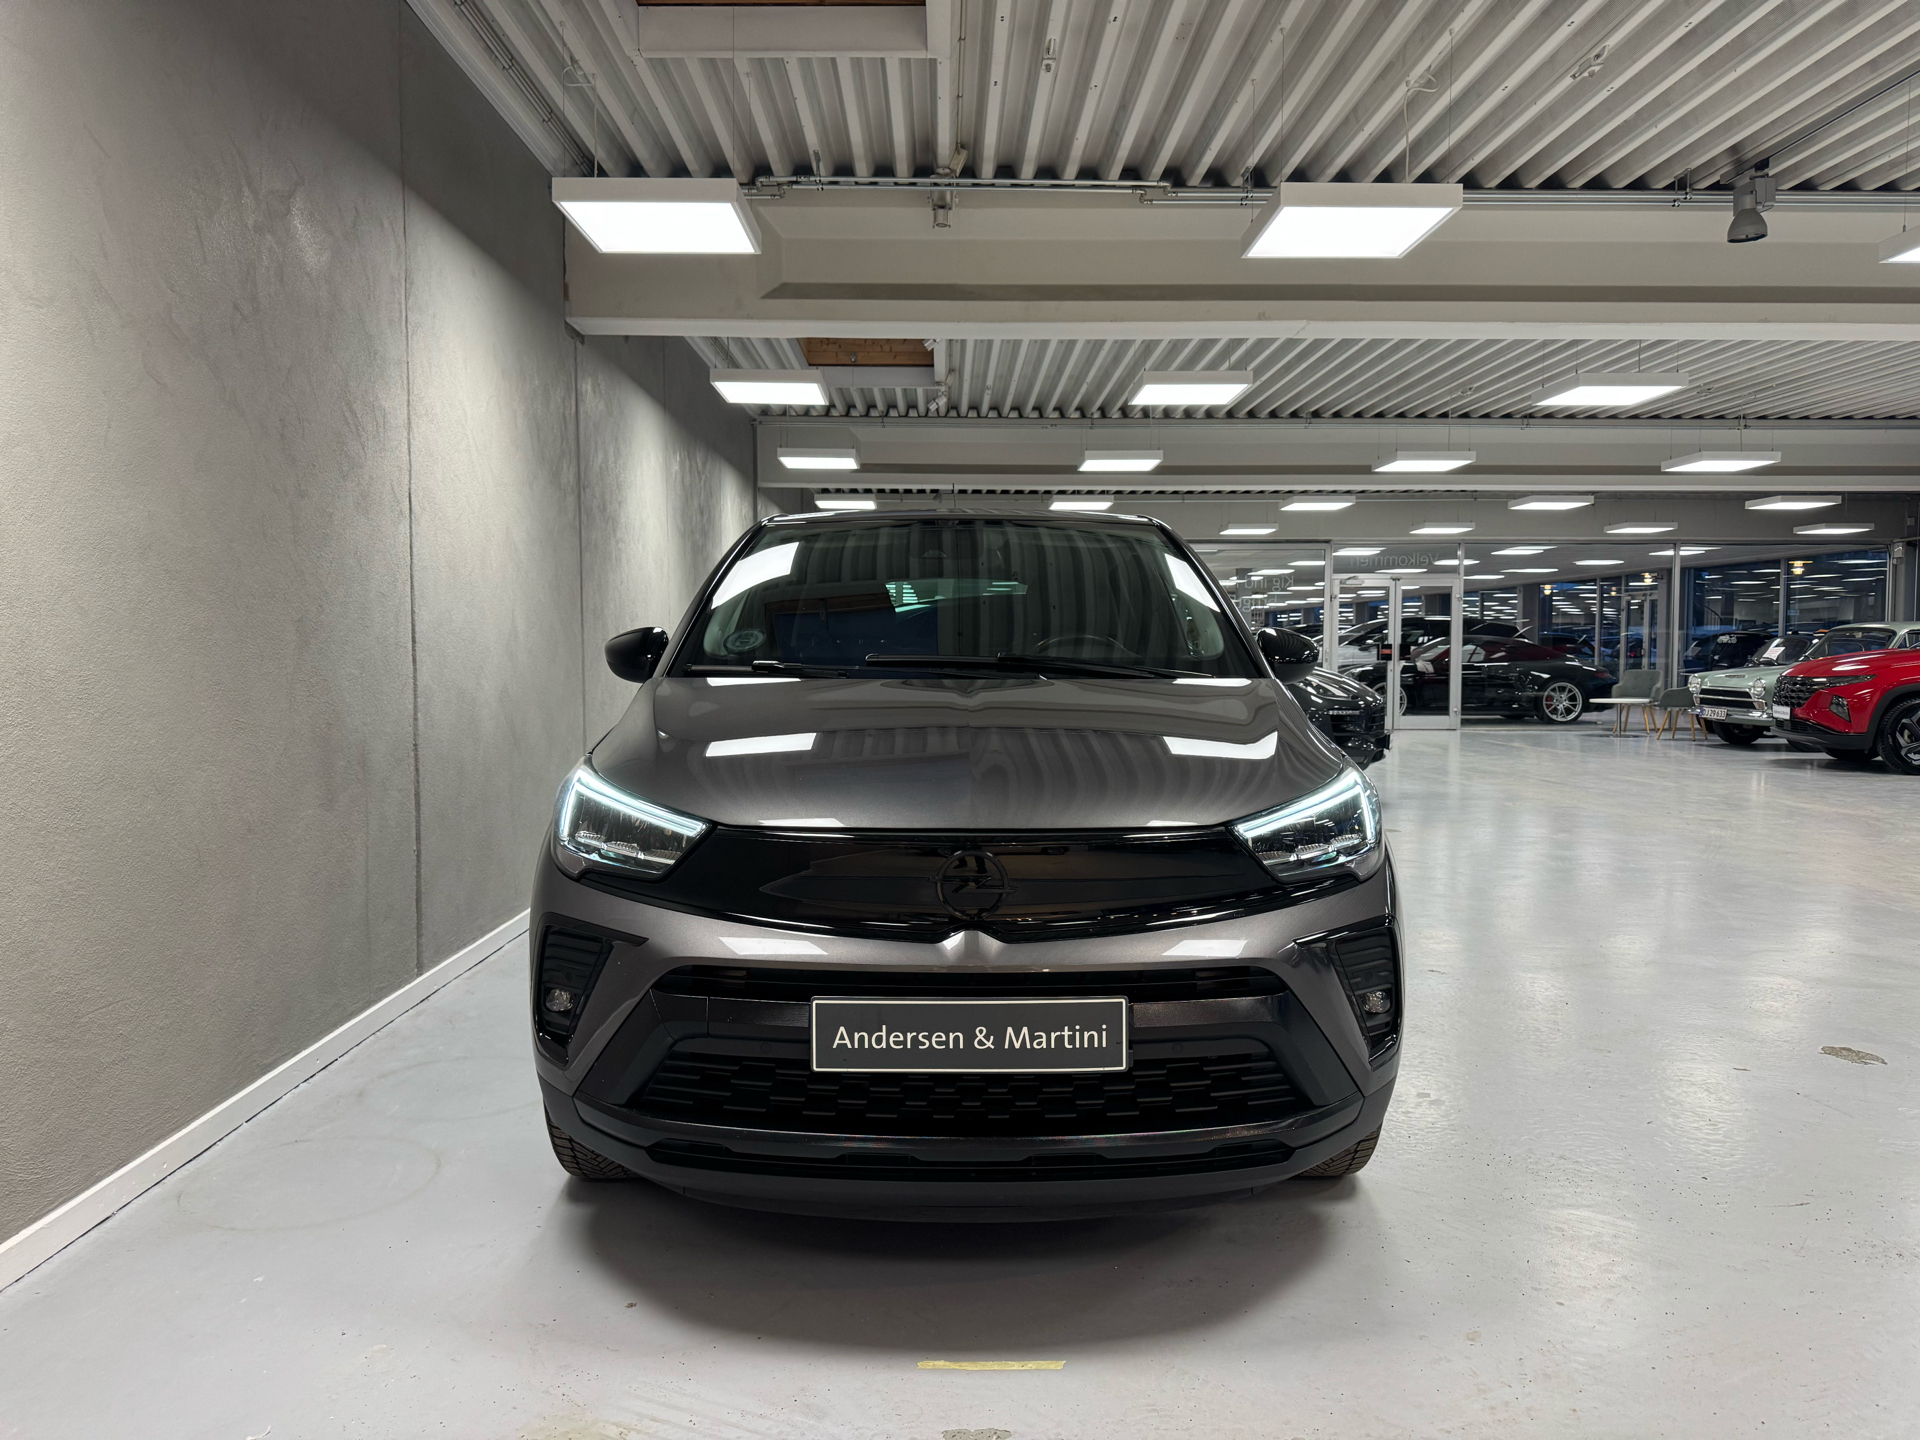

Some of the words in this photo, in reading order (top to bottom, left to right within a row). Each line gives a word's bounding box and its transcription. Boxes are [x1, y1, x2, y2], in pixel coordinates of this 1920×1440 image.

[833, 1025, 963, 1049] Andersen
[973, 1026, 995, 1050] &
[1004, 1024, 1107, 1049] Martini
